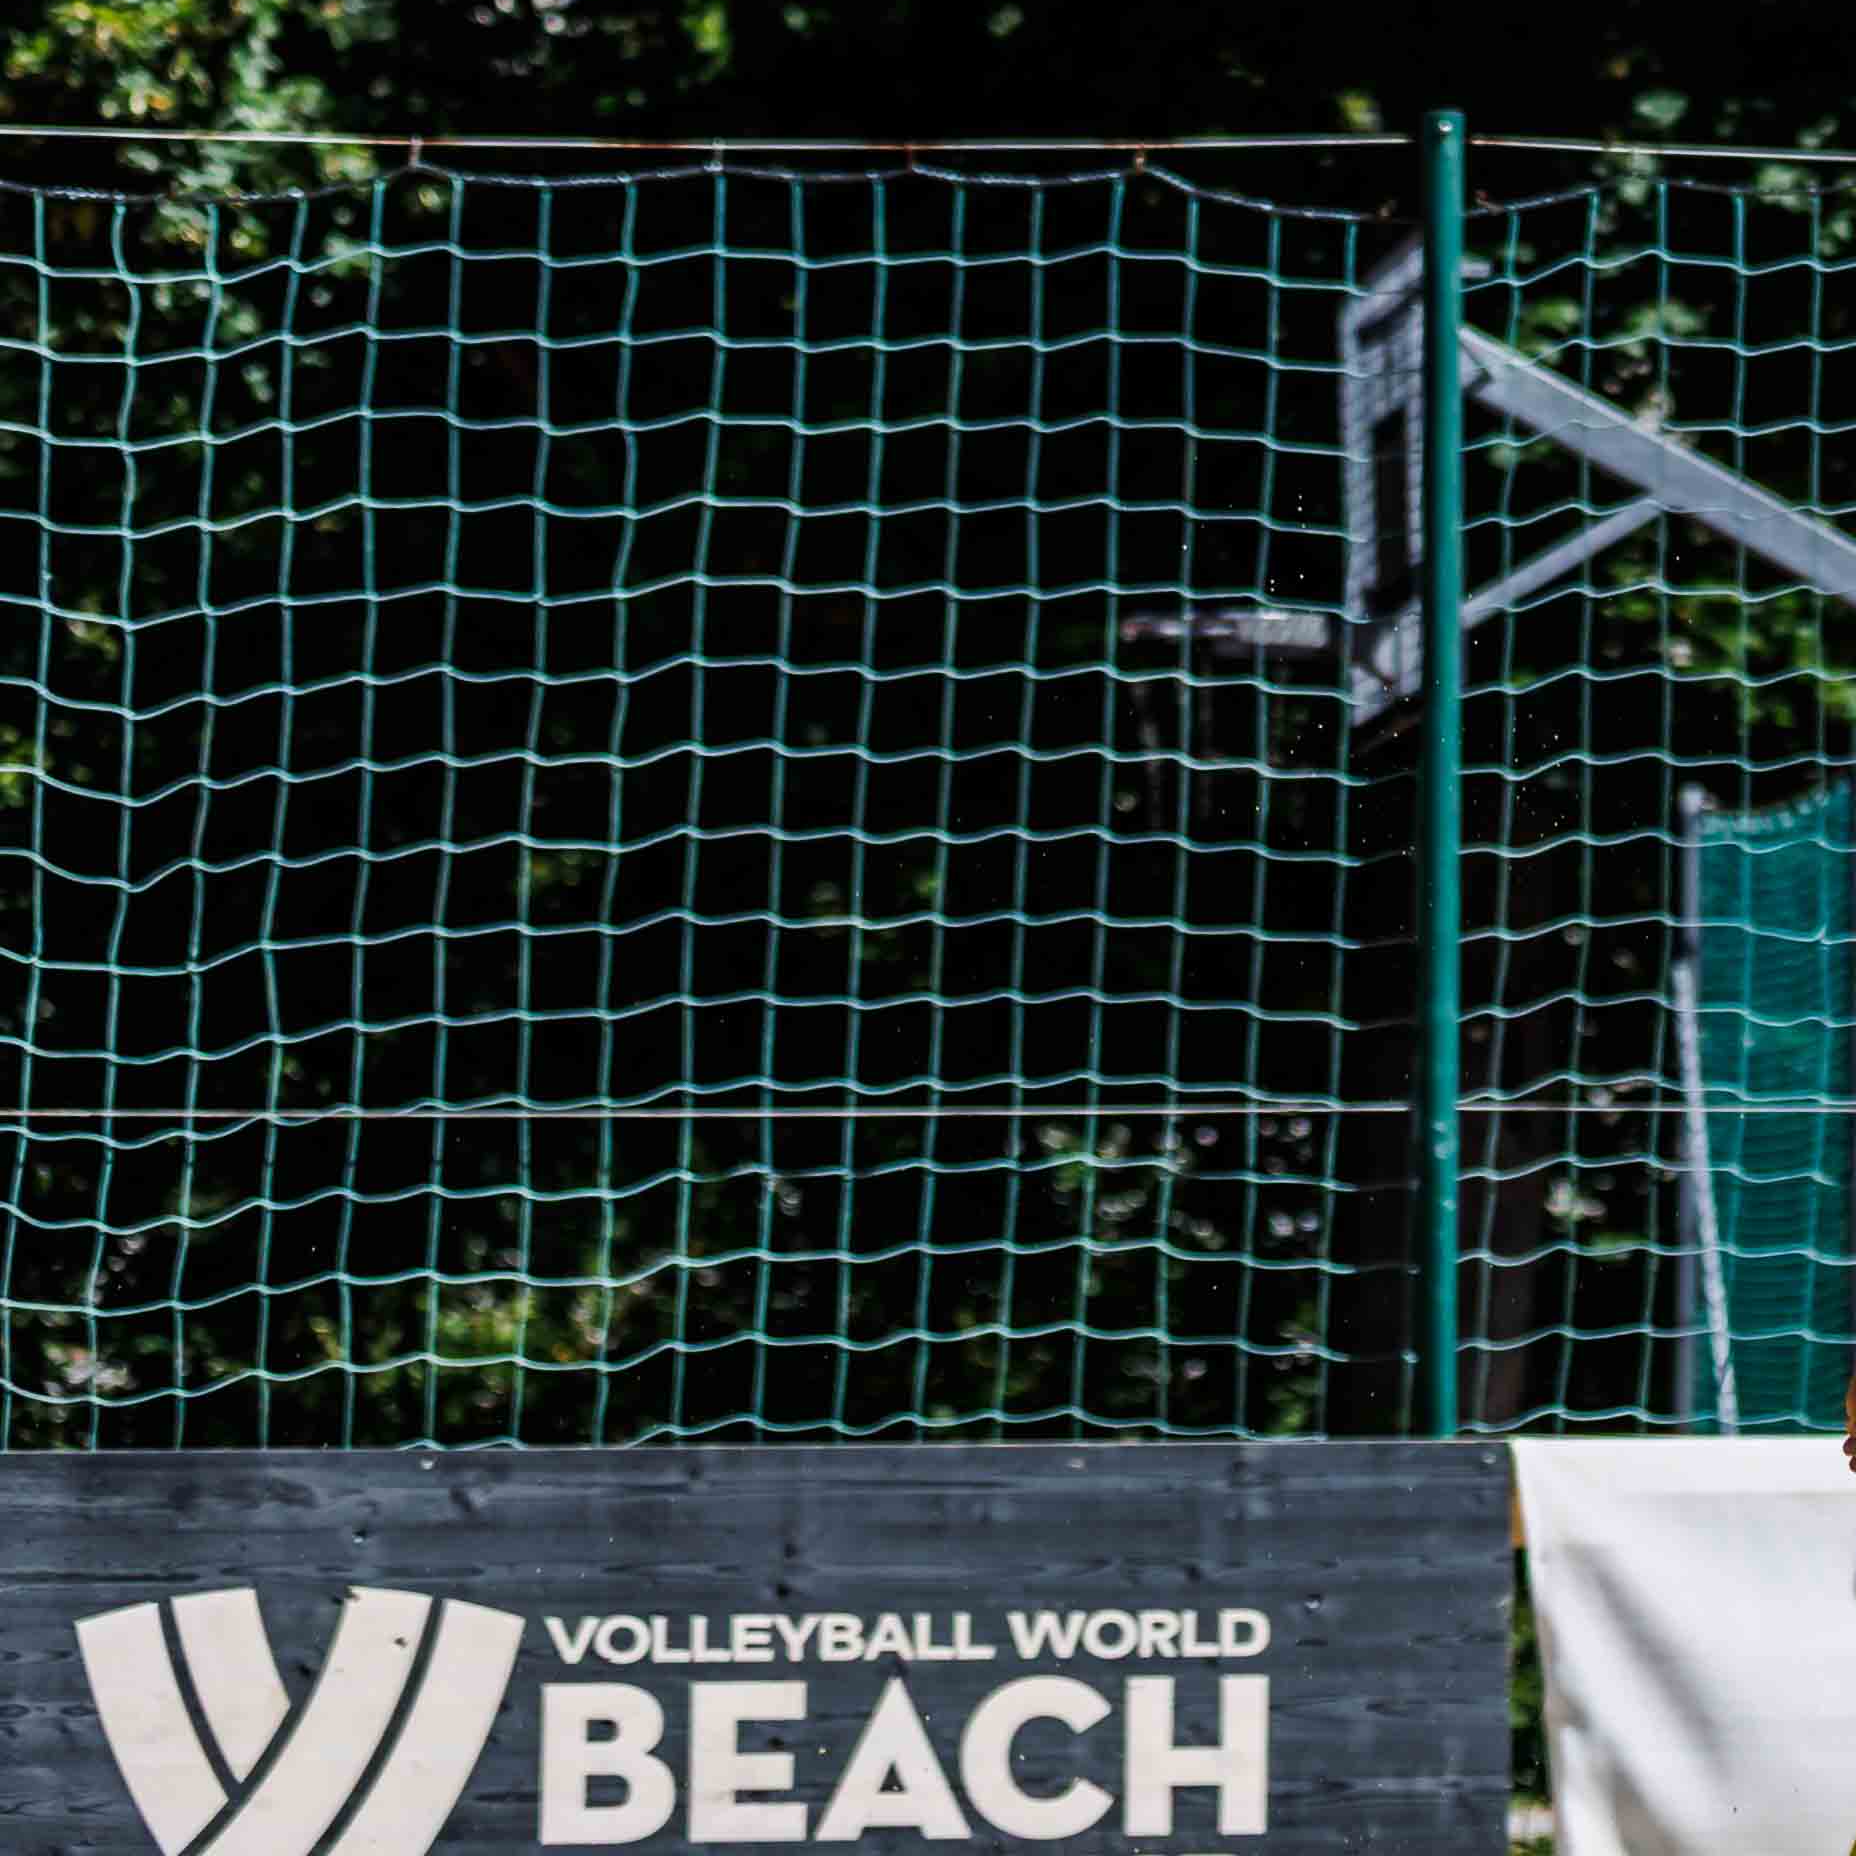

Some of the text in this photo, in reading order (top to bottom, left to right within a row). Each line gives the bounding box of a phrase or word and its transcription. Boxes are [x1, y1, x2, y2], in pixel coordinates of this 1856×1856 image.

[546, 1608, 1271, 1665] VOLLEYBALL WORLD
[539, 1674, 1270, 1846] BEACH
